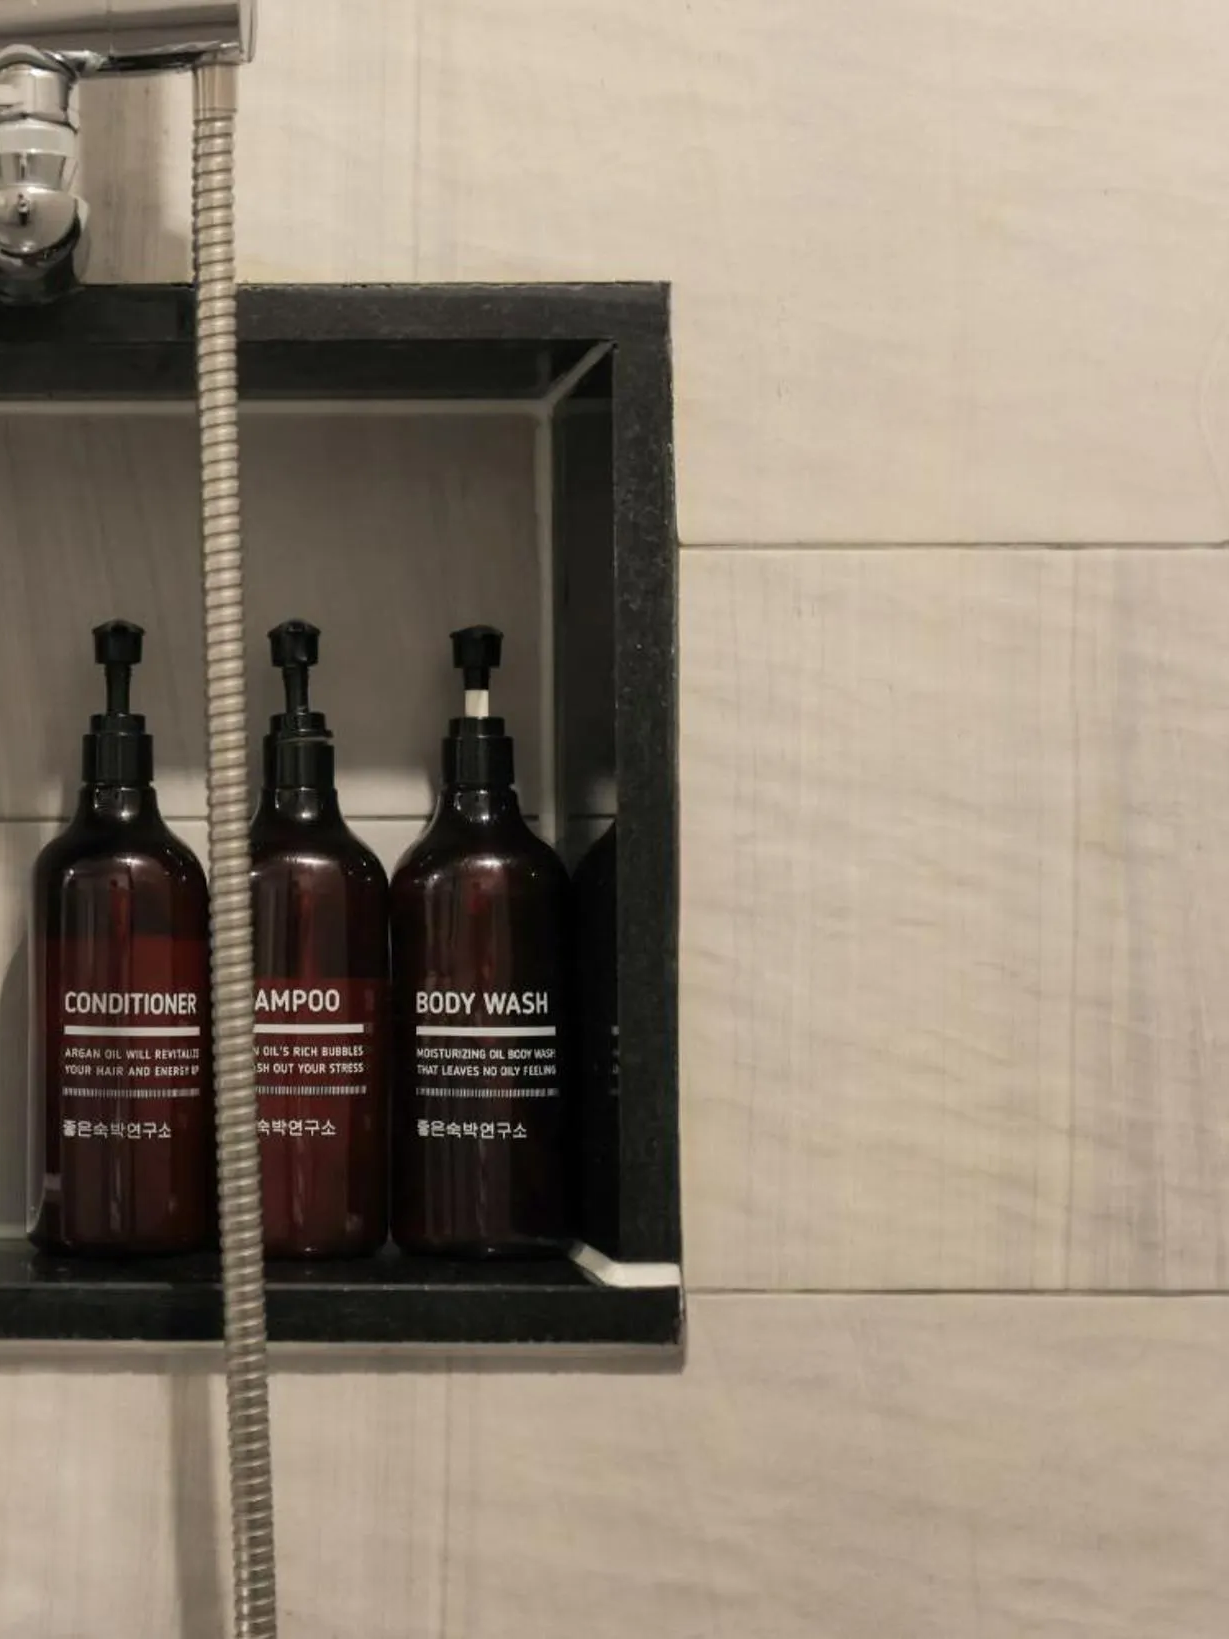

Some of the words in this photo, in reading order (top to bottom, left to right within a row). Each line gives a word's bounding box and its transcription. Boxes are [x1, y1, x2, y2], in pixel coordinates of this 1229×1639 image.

[64, 991, 197, 1015] CONDITIONER
[255, 989, 340, 1012] AMPOO
[416, 991, 476, 1015] BODY
[483, 991, 548, 1015] WASH
[64, 1048, 101, 1059] ARGAN
[104, 1048, 122, 1060] OIL
[126, 1049, 151, 1060] WILL
[263, 1046, 290, 1057] OIL'S
[293, 1046, 318, 1057] RICH
[322, 1046, 364, 1057] BUBBLES
[416, 1048, 486, 1060] MOISTURIZING
[489, 1049, 505, 1060] OIL
[507, 1049, 532, 1060] BODY
[534, 1048, 556, 1059] WASH
[64, 1065, 91, 1076] YOUR
[96, 1066, 124, 1076] HAIR
[128, 1066, 151, 1076] AND
[155, 1066, 190, 1076] ENERGY
[273, 1063, 294, 1074] OUT
[297, 1063, 326, 1074] YOUR
[329, 1063, 364, 1074] STRESS
[417, 1065, 439, 1075] THAT
[441, 1065, 479, 1076] LEAVES
[482, 1066, 498, 1076] NO
[500, 1066, 520, 1076] OILY
[523, 1065, 557, 1076] FEELING
[256, 1119, 337, 1137] 숙박연구소
[417, 1119, 528, 1139] 좋은숙박연구소
